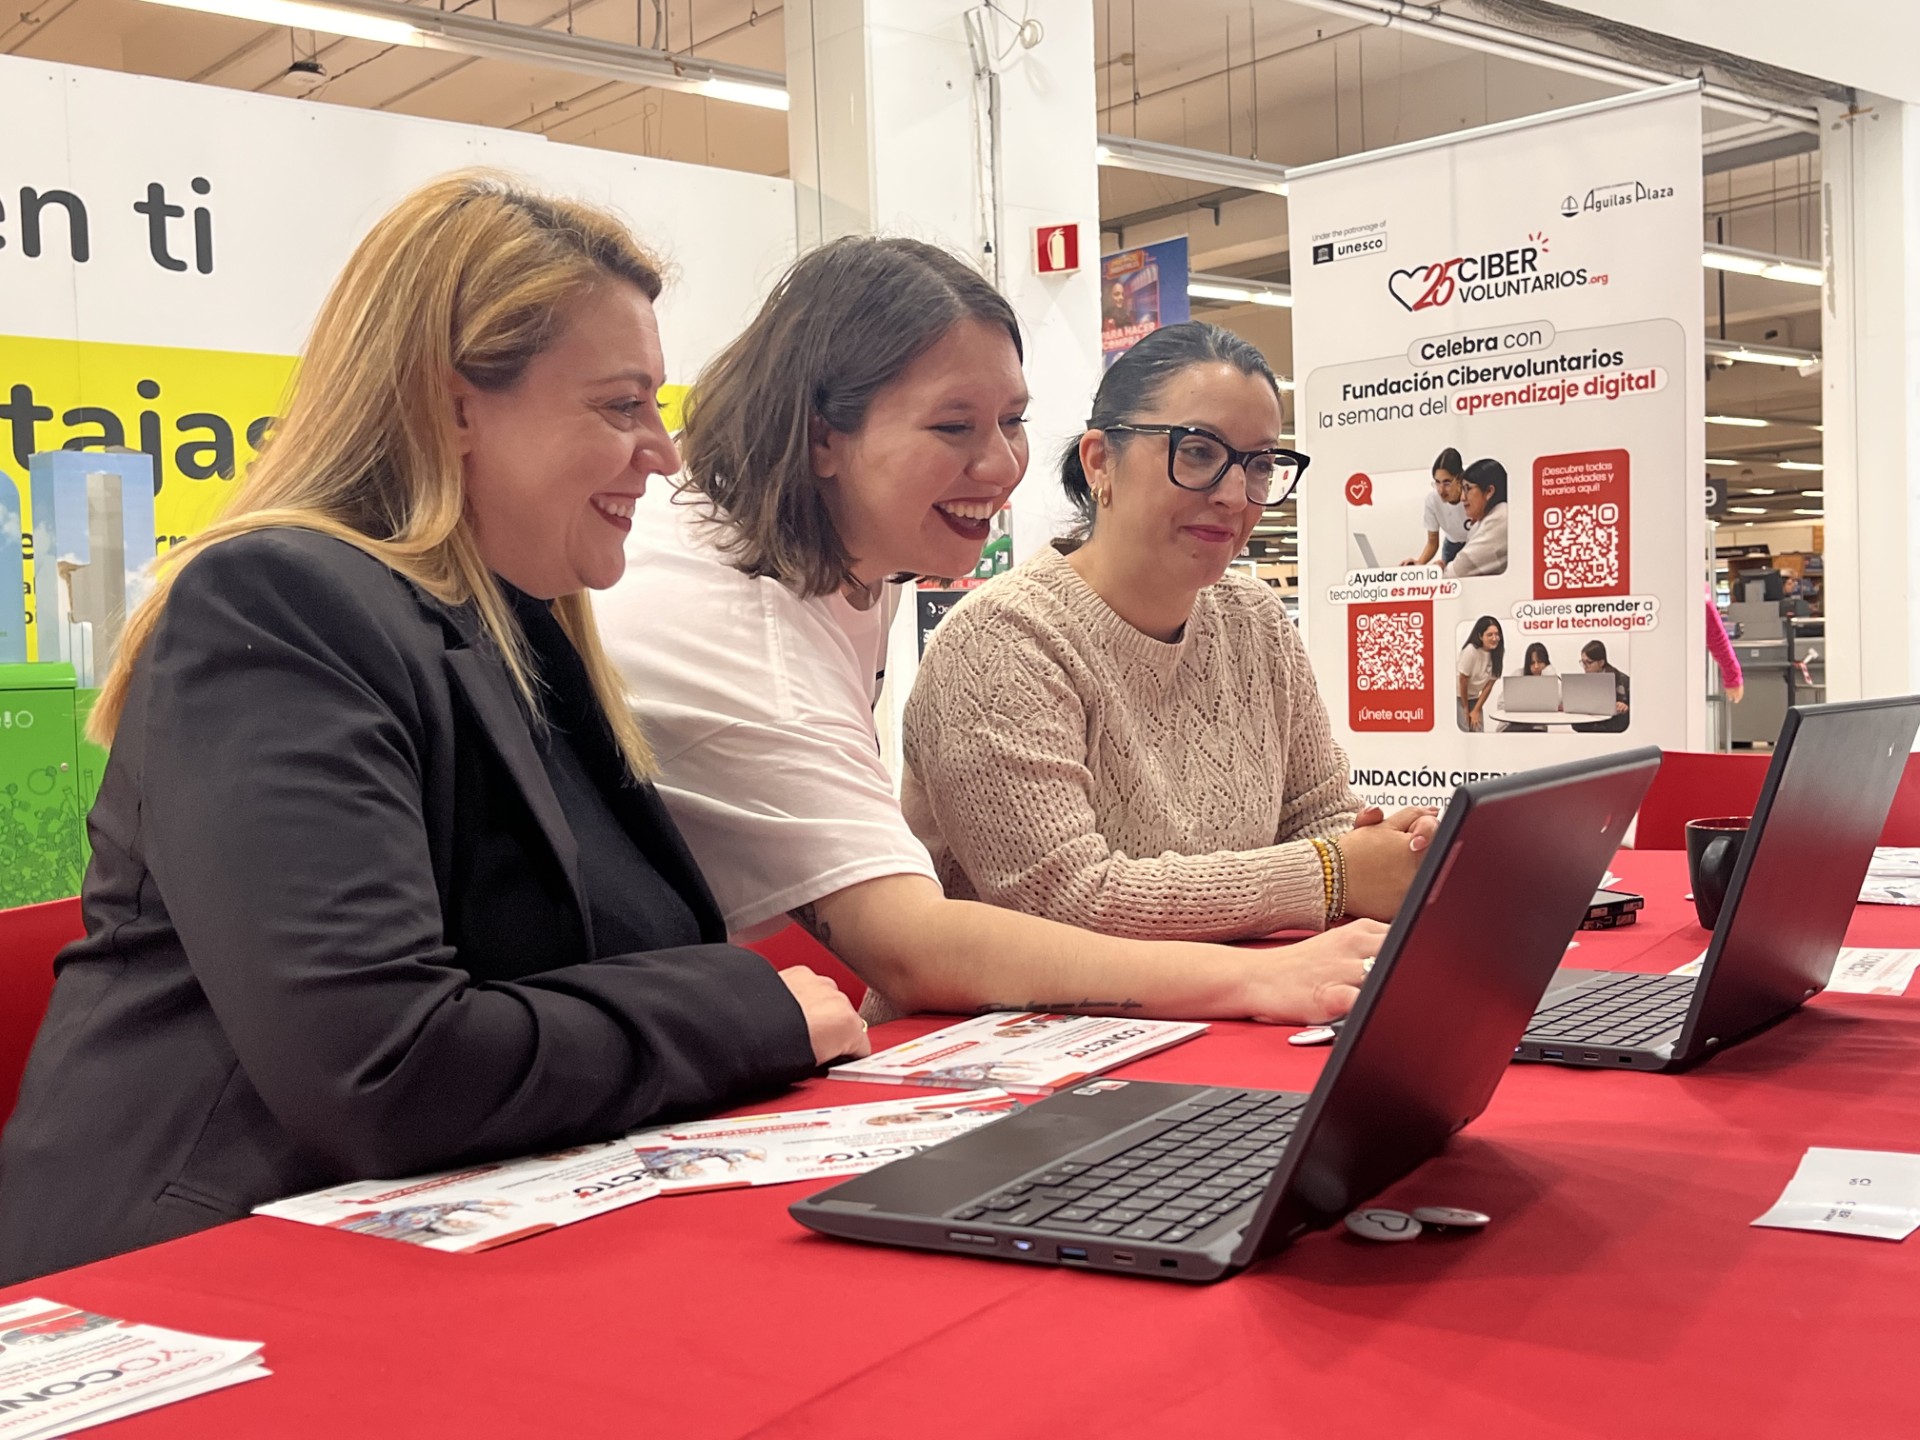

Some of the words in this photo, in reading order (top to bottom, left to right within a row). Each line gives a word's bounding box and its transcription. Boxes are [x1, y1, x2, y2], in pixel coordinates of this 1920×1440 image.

[0, 186, 89, 263] n
[133, 176, 213, 274] ti
[1312, 233, 1331, 242] Under
[1338, 239, 1383, 256] unesco
[1457, 247, 1538, 283] CIBER
[1421, 334, 1499, 360] Celebra
[1503, 329, 1542, 350] con
[1342, 371, 1444, 401] Fundación
[1447, 348, 1624, 387] Cibervoluntarios
[1319, 410, 1333, 429] la
[1337, 401, 1413, 426] semana
[1419, 395, 1448, 417] del
[1456, 378, 1579, 415] aprendizaje
[1583, 369, 1657, 400] digital
[1586, 462, 1613, 472] todas
[1541, 477, 1554, 486] las
[1556, 473, 1606, 485] actividades
[1608, 473, 1614, 483] y
[1542, 486, 1576, 496] horarios
[1348, 571, 1397, 587] ¿Ayudar
[1400, 571, 1424, 580] con
[1427, 568, 1438, 580] la
[1330, 586, 1388, 601] tecnología
[1390, 587, 1405, 597] es
[1407, 585, 1437, 599] muy
[1439, 582, 1458, 595] tú?
[1516, 603, 1572, 618] ¿Quieres
[1575, 600, 1640, 617] aprender
[1643, 601, 1653, 611] a
[1523, 619, 1554, 630] usar
[1556, 617, 1569, 629] la
[1571, 613, 1653, 630] tecnología?
[1358, 705, 1392, 723] ¡Únete
[1394, 706, 1424, 722] aquí!
[1350, 765, 1446, 787] UNDACIÓN
[1399, 795, 1408, 806] a
